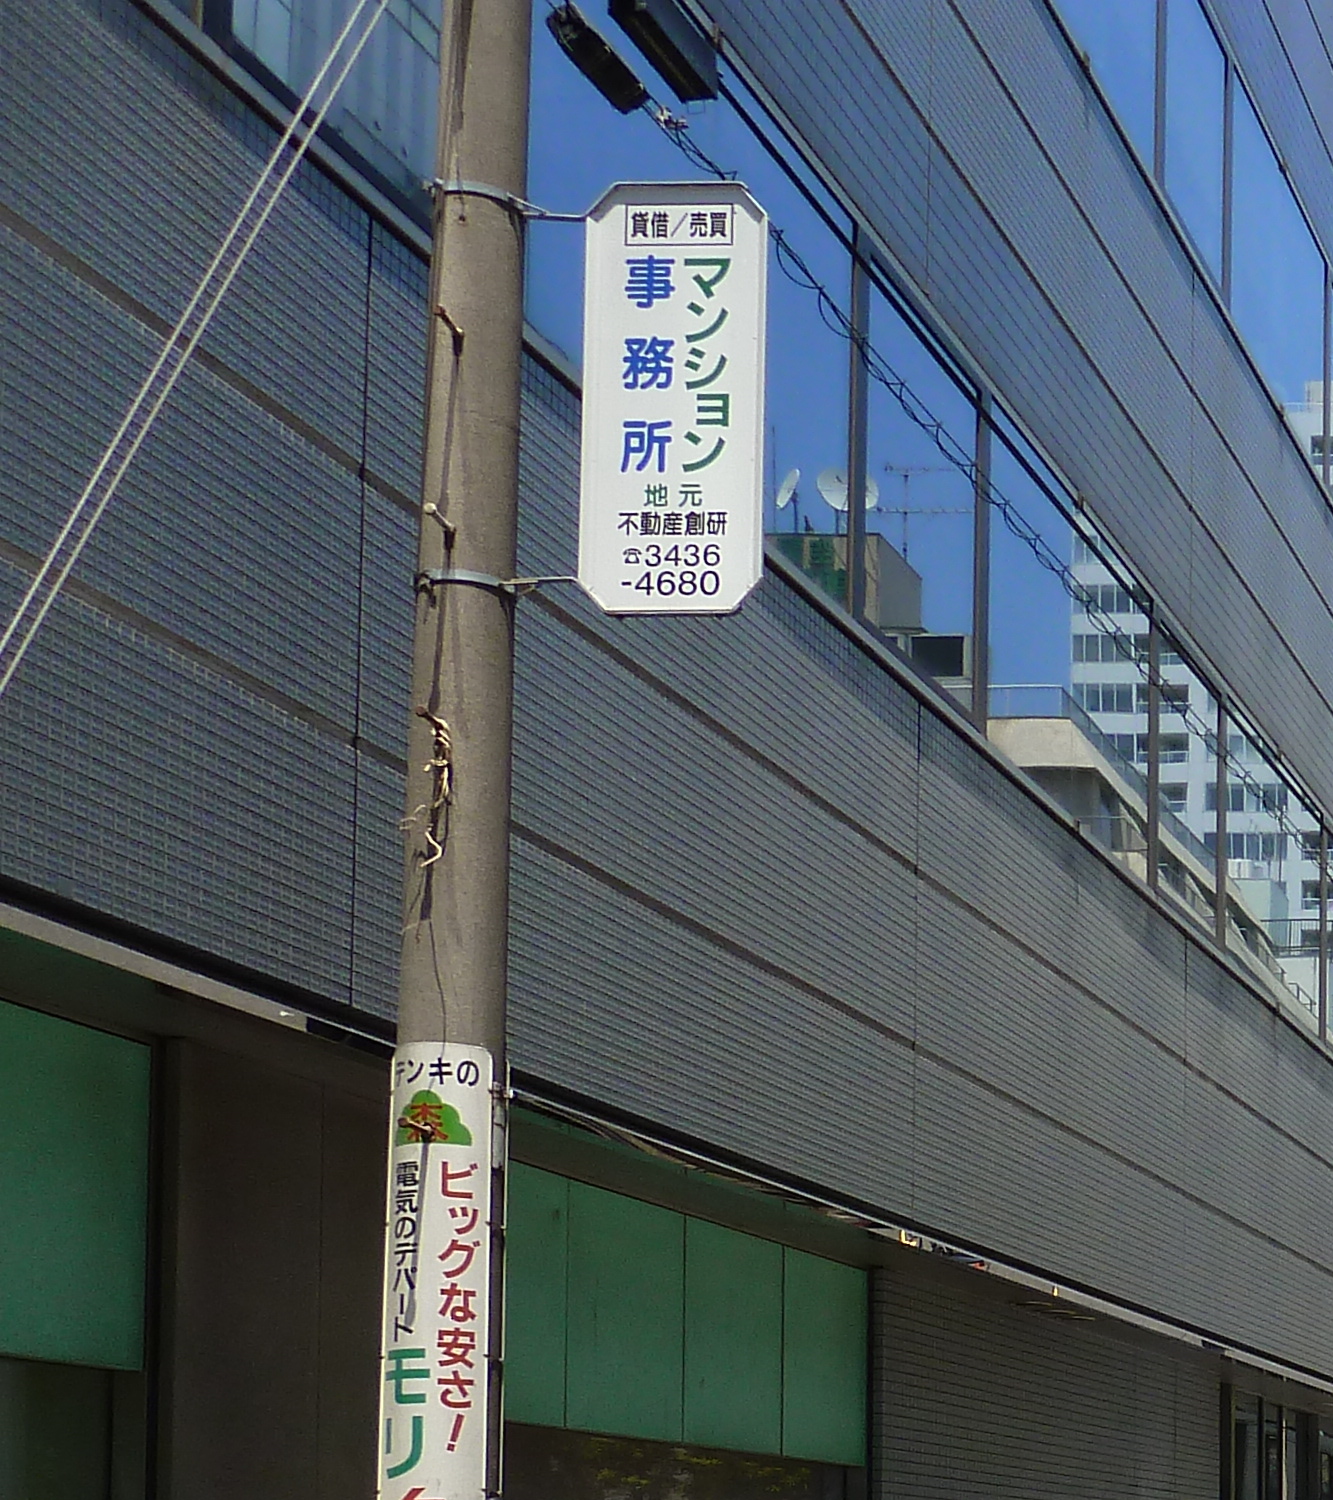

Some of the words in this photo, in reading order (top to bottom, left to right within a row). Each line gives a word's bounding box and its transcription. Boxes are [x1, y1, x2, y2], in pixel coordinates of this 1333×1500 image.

[620, 254, 676, 473] 事務所
[683, 257, 732, 473] マンション
[617, 511, 728, 537] 不動産創研
[393, 1161, 420, 1342] 電気のデパート
[436, 1160, 481, 1453] ビッグな安さ！
[385, 1347, 431, 1480] モリ
